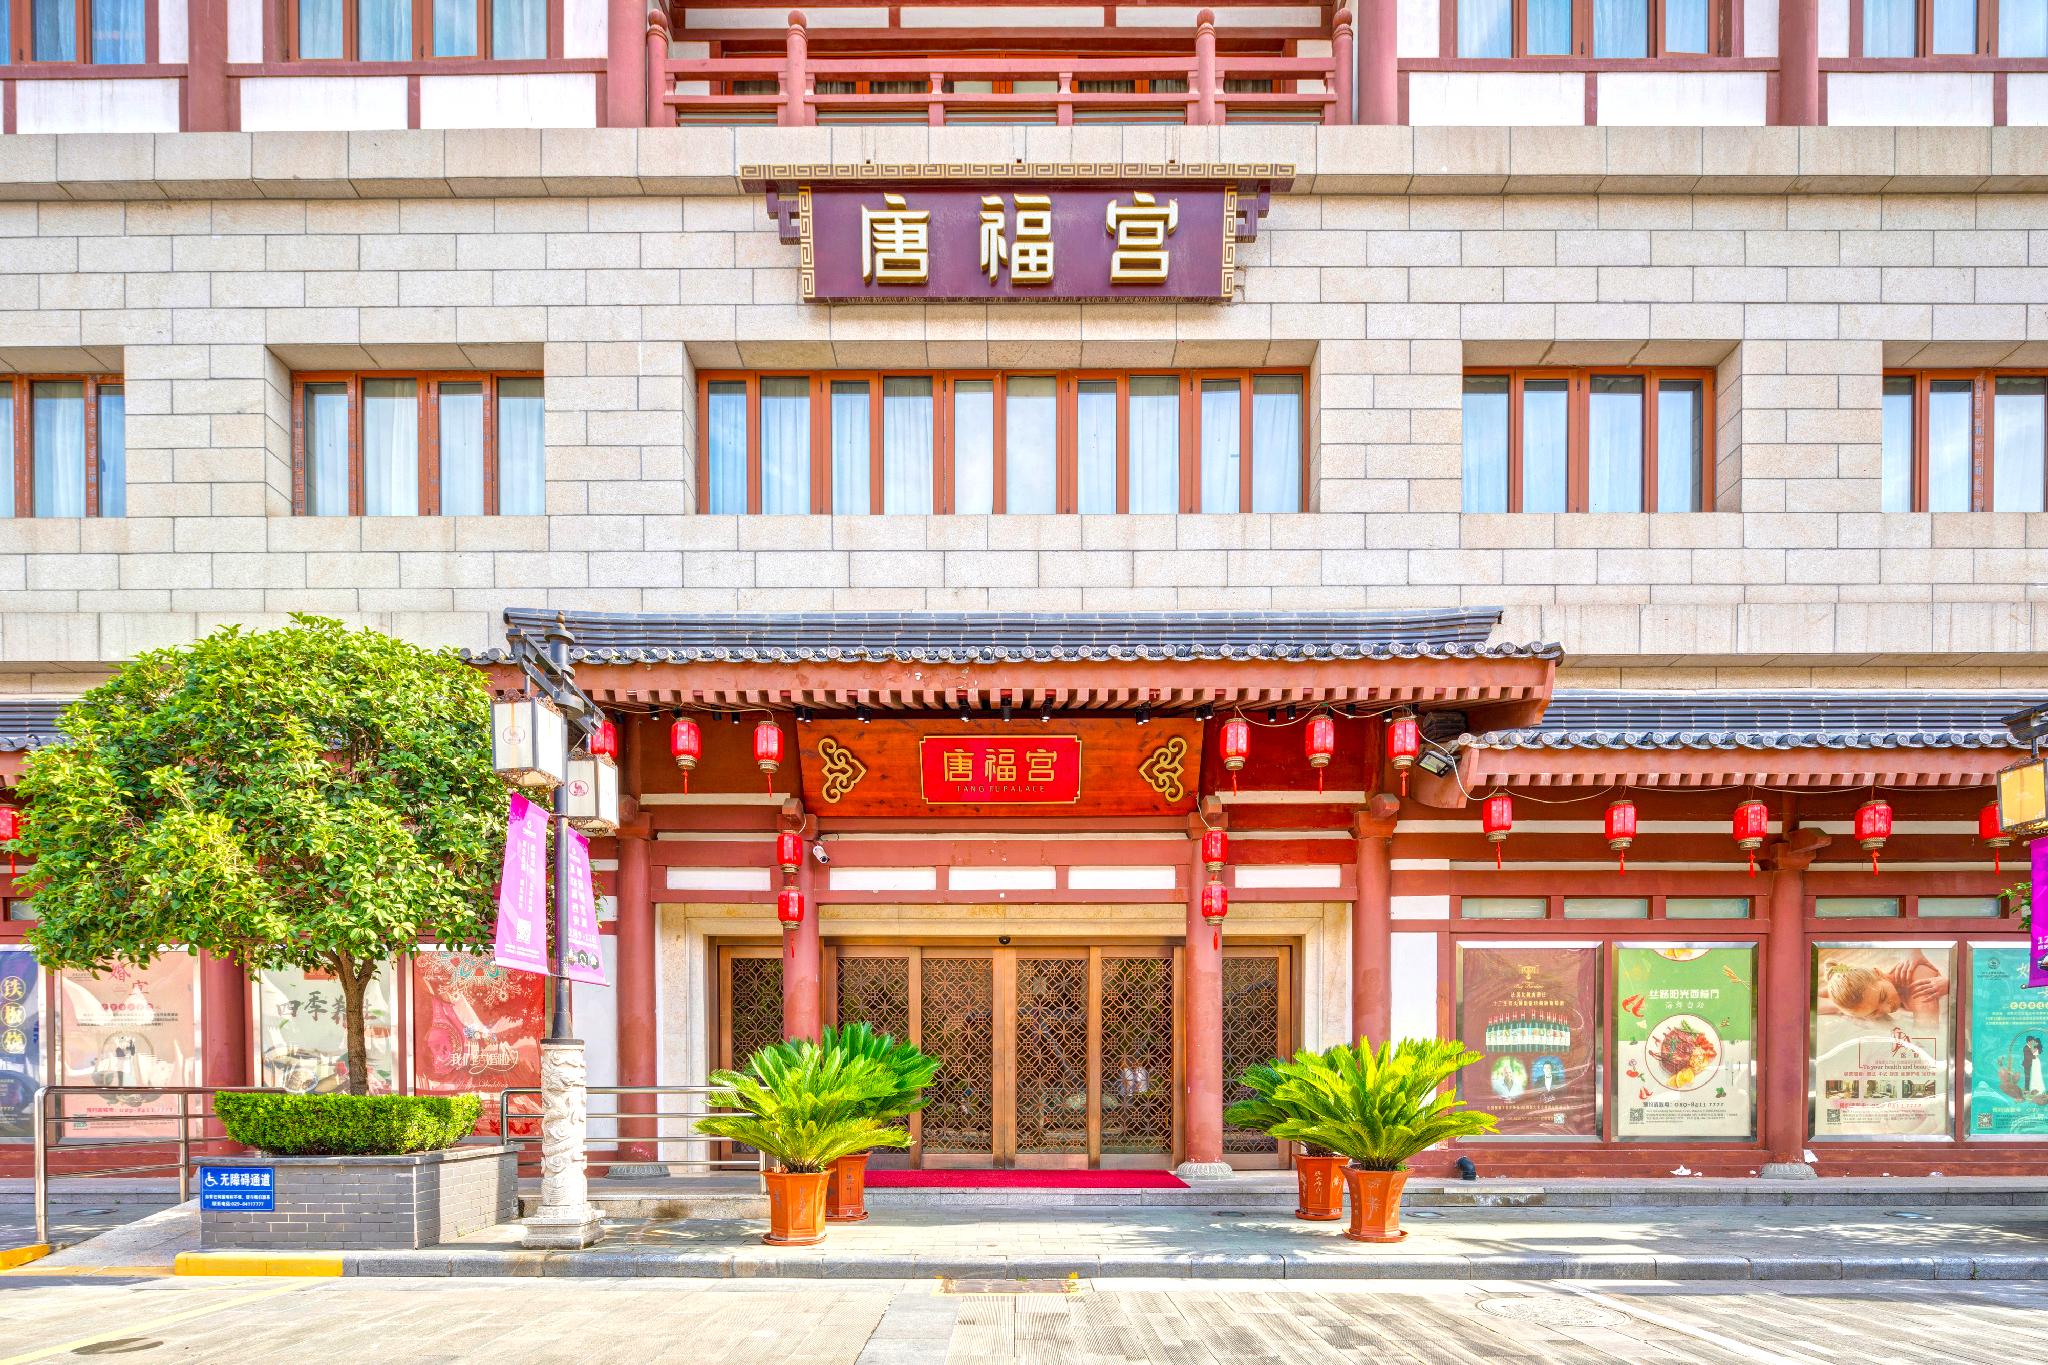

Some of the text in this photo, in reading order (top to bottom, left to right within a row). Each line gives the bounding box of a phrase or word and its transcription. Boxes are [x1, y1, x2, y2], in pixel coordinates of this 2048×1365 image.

[861, 192, 1178, 285] 唐福宫
[943, 748, 1057, 782] 唐福宫
[956, 785, 985, 793] TANG
[1003, 785, 1045, 793] PALACE
[220, 1172, 271, 1186] 无障碍通道
